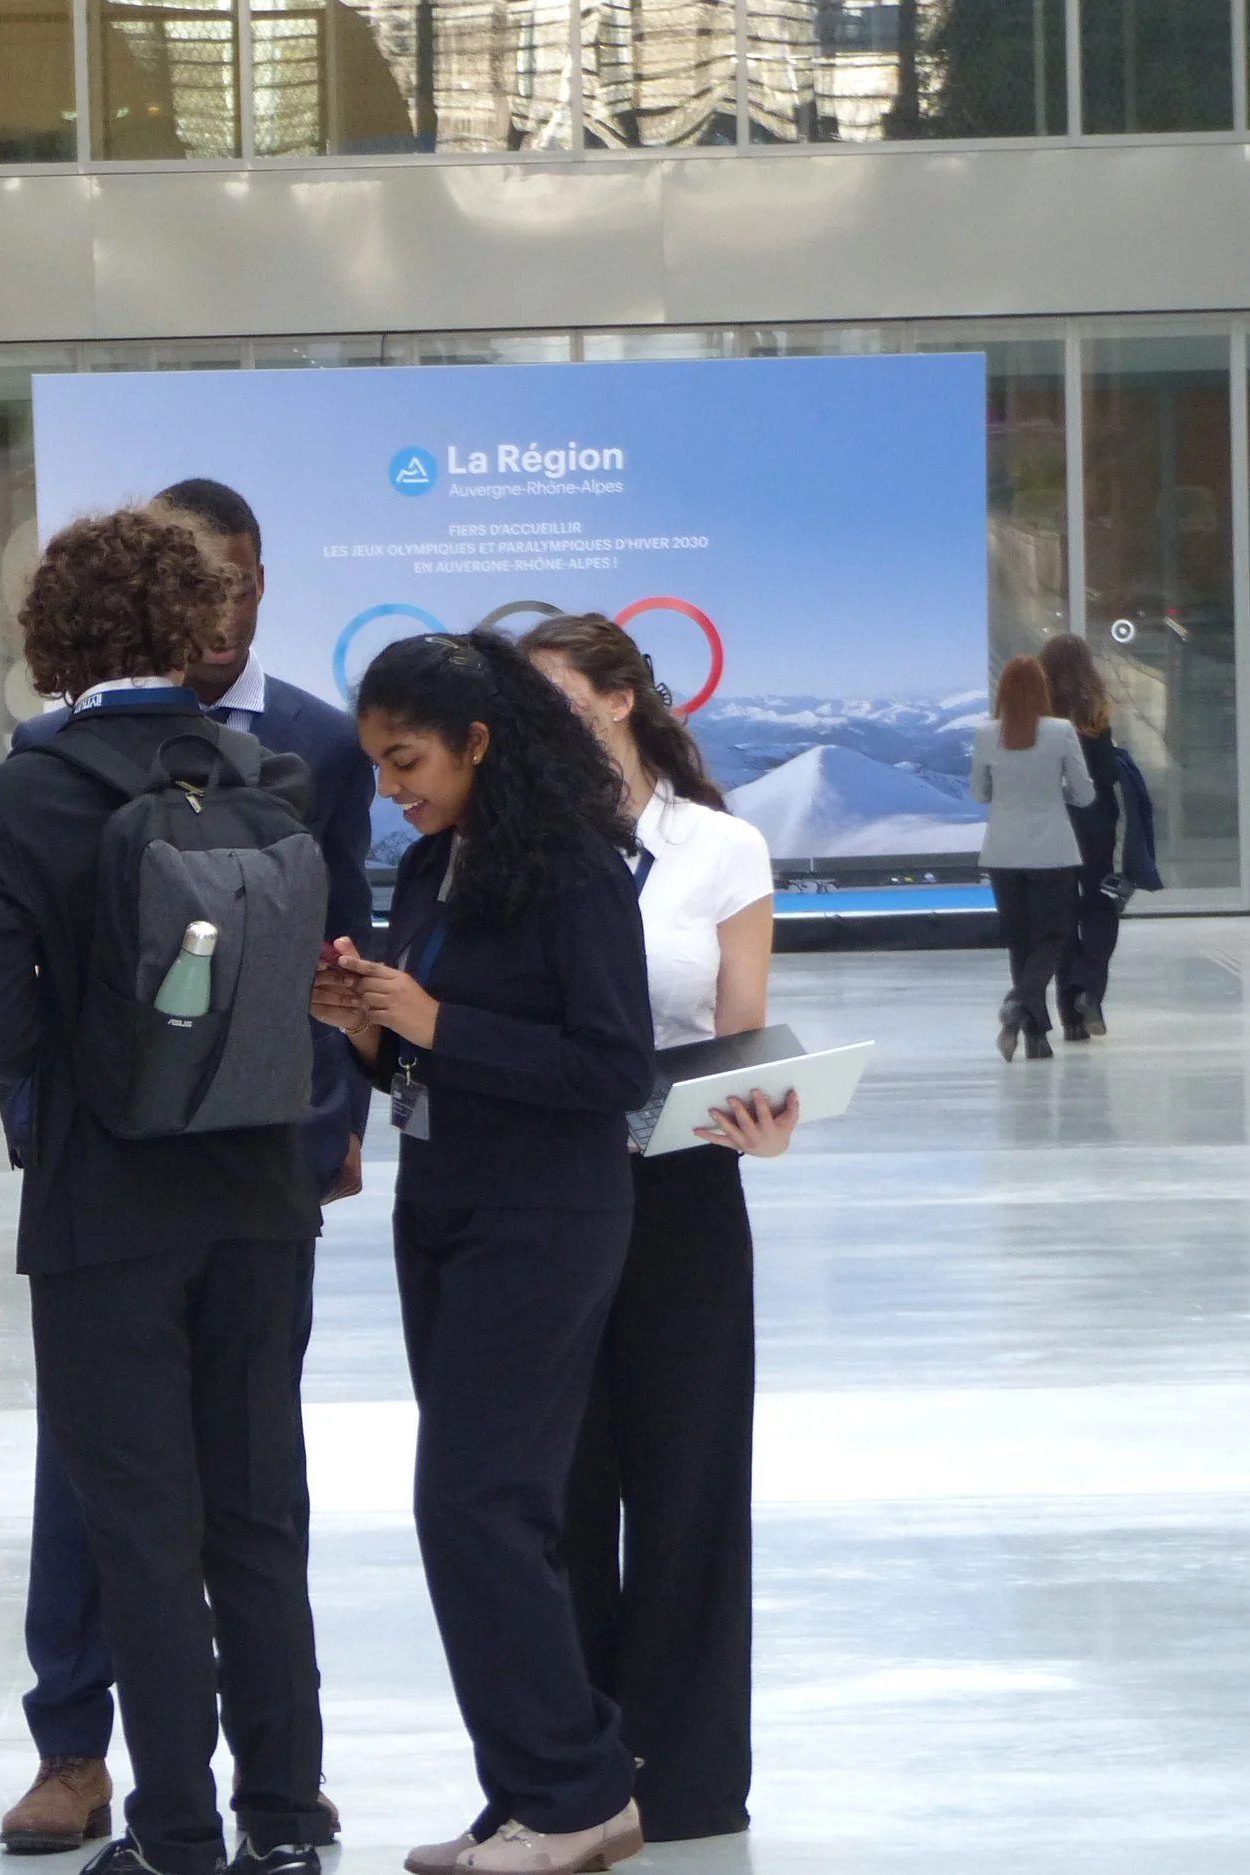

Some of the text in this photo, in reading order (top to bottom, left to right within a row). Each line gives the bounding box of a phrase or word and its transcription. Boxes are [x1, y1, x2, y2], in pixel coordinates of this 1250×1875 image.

[447, 441, 624, 479] La Région
[448, 479, 624, 499] Auvergne-Rhône-Alpes
[449, 522, 582, 537] FIERS D'ACCUEILLIR
[323, 536, 710, 558] LES JEUX OLYMPIQUES ET PARALYMPIQUES D'HIVER 2030
[413, 561, 433, 574] EN
[435, 555, 610, 573] AUVERGNE-RHÔNE-ALPES
[167, 1018, 193, 1028] ASUS
